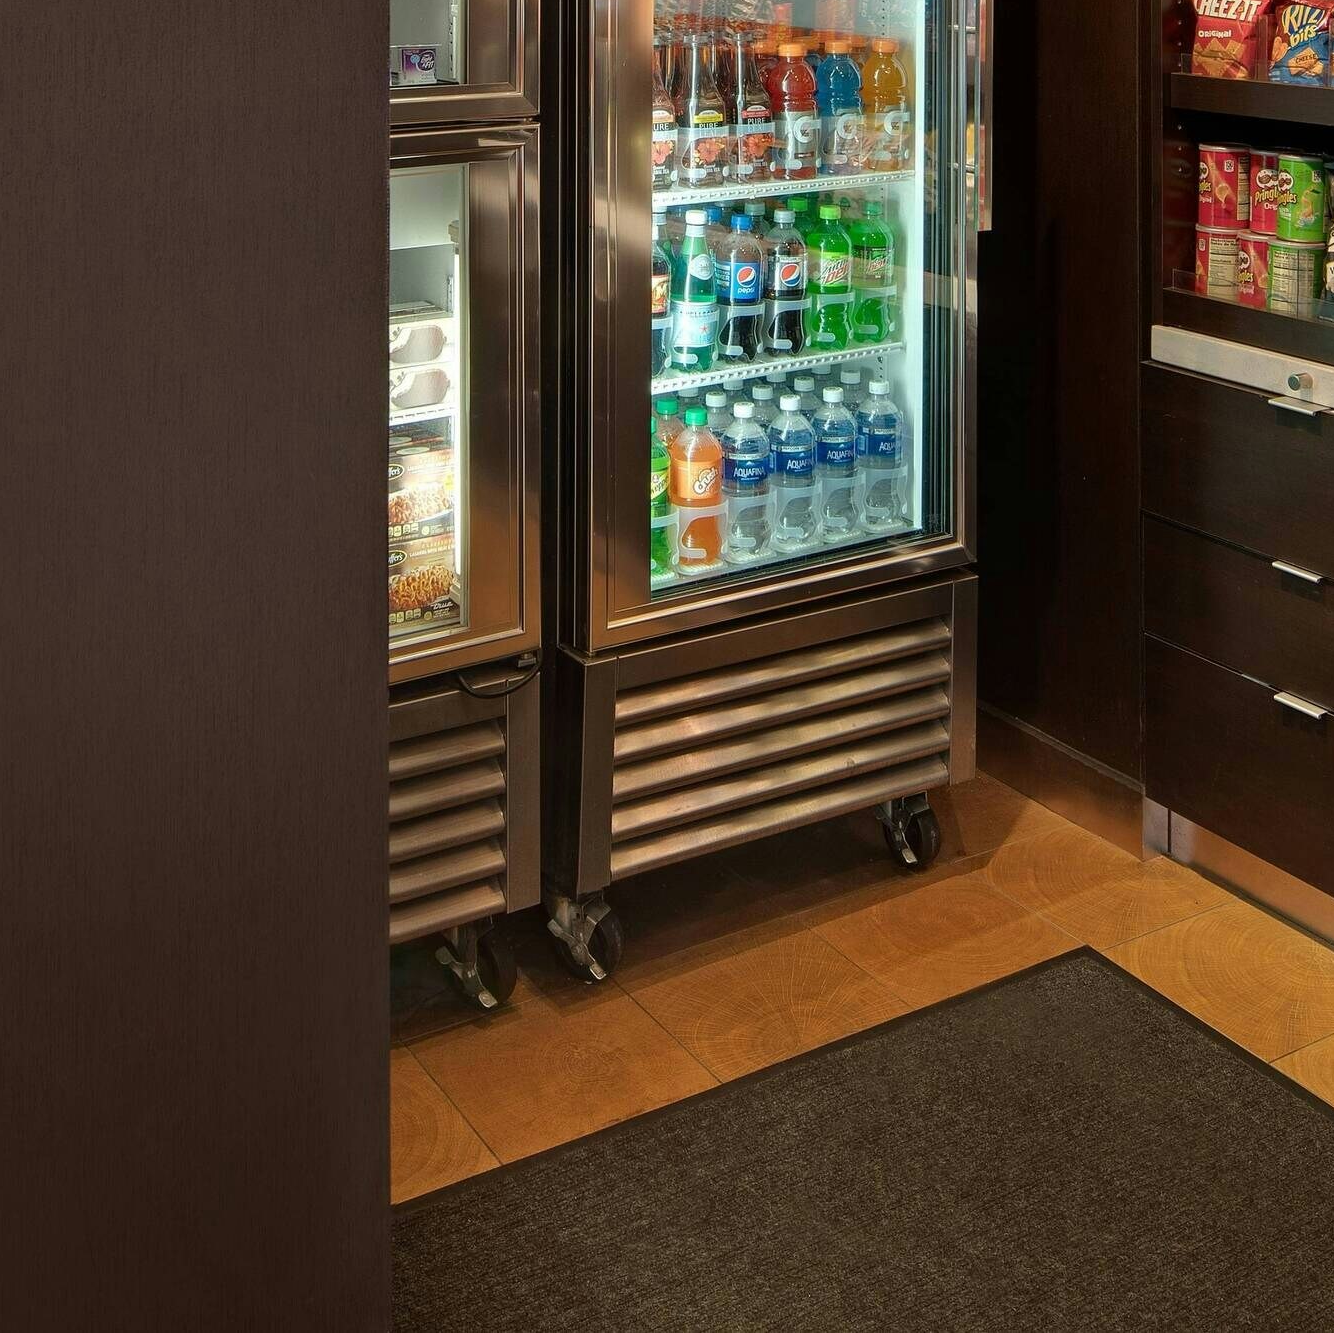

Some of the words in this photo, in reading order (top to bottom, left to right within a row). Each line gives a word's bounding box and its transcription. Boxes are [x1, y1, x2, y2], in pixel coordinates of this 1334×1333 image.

[1282, 4, 1326, 34] RITZ
[653, 122, 669, 131] URE
[747, 117, 765, 125] PURE
[1255, 187, 1278, 206] Pringl
[738, 287, 755, 295] pepsi
[827, 447, 855, 459] AQUAFIN
[787, 457, 815, 470] AQUAFIN
[693, 467, 718, 495] Crush
